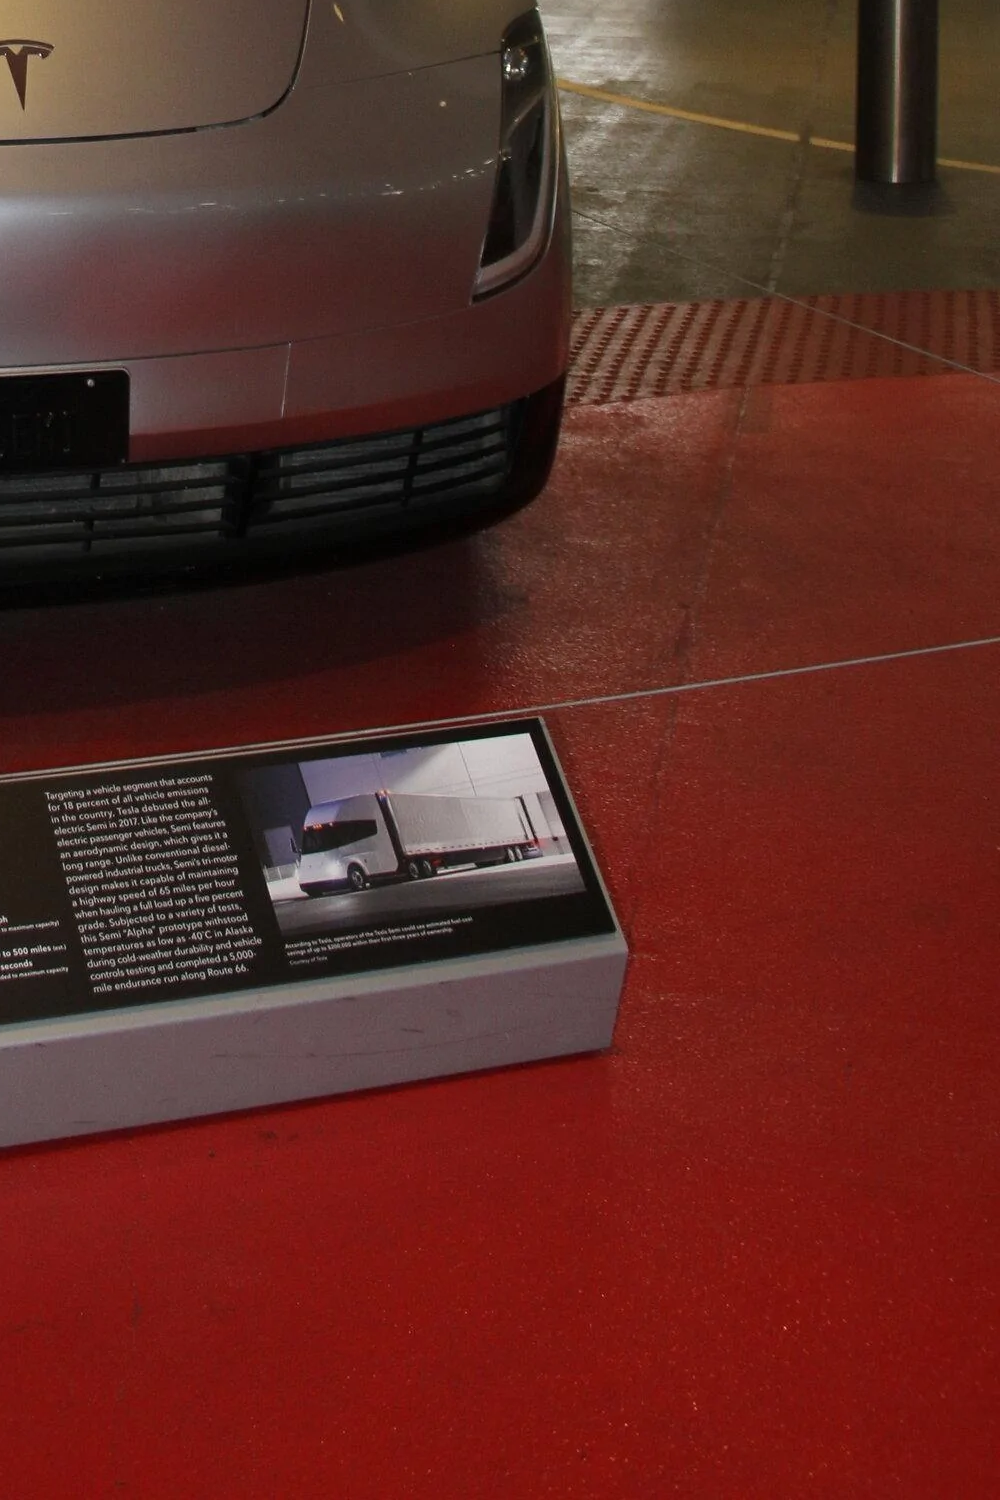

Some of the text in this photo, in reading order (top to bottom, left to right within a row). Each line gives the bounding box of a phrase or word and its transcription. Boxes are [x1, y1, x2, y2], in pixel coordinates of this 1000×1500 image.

[44, 790, 85, 801] Targeting
[92, 784, 121, 795] vehicle
[122, 780, 158, 792] segment
[159, 778, 176, 787] that
[177, 775, 213, 785] accounts
[47, 787, 209, 812] for 18 percent of all vehicle emissions
[50, 816, 60, 824] in
[61, 814, 77, 823] the
[116, 805, 140, 815] Tesla
[141, 800, 179, 813] debuted
[180, 799, 196, 808] the
[54, 825, 86, 835] electric
[86, 821, 108, 832] Semi
[140, 816, 158, 825] Like
[159, 814, 173, 823] the
[57, 836, 88, 848] electric
[89, 832, 132, 845] passenger
[170, 823, 192, 833] Semi
[192, 820, 226, 830] features
[73, 843, 129, 857] aerodynamic
[163, 835, 189, 846] which
[190, 834, 213, 844] gives
[62, 862, 84, 871] long
[115, 854, 143, 864] Unlike
[145, 846, 200, 860] conventional
[66, 870, 104, 885] powered
[105, 865, 144, 878] industrial
[201, 855, 238, 865] tri-motor
[68, 867, 239, 895] design makes it capable of maintaining
[79, 895, 116, 907] highway
[118, 889, 146, 902] speed
[148, 887, 157, 897] of
[159, 886, 171, 895] 65
[173, 884, 196, 893] miles
[198, 882, 212, 892] per
[214, 879, 235, 888] hour
[74, 910, 98, 919] when
[99, 905, 132, 916] hauling
[139, 900, 153, 910] full
[153, 898, 174, 908] load
[174, 898, 187, 907] up
[188, 897, 194, 905] a
[194, 894, 210, 903] five
[211, 890, 244, 903] percent
[108, 913, 154, 927] Subjected
[156, 913, 166, 921] to
[168, 912, 174, 920] a
[175, 908, 205, 918] variety
[207, 904, 217, 914] of
[80, 934, 97, 943] this
[98, 930, 122, 941] Semi
[158, 921, 203, 935] prototype
[204, 912, 248, 927] withstood
[83, 942, 144, 956] temperatures
[157, 937, 174, 945] low
[225, 925, 253, 936] Alaska
[12, 947, 29, 956] 500
[30, 945, 52, 954] miles
[87, 936, 262, 968] during cold-weather durability and vehicle
[0, 959, 33, 971] seconds
[90, 968, 125, 981] controls
[125, 965, 156, 976] testing
[157, 961, 174, 972] and
[175, 954, 221, 969] completed
[93, 983, 112, 993] mile
[114, 977, 162, 990] endurance
[163, 975, 179, 983] run
[181, 971, 206, 981] along
[207, 967, 233, 977] Route
